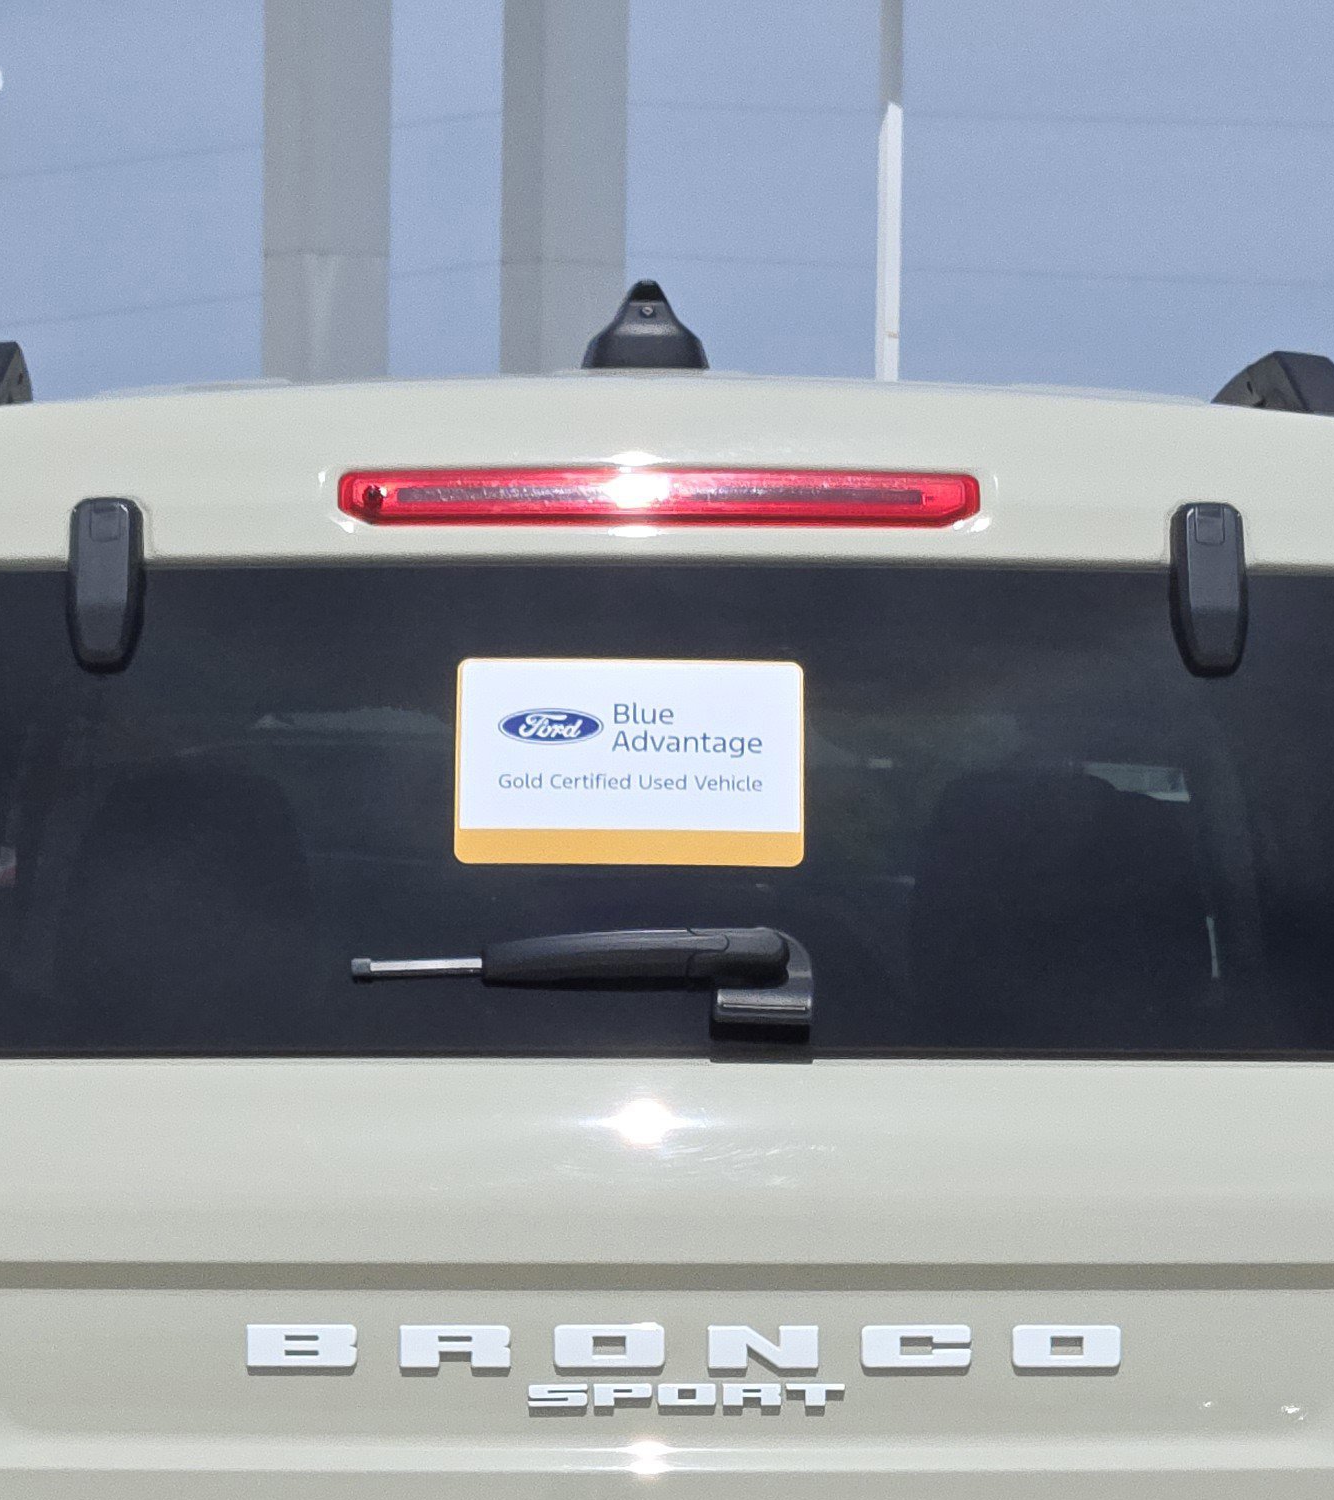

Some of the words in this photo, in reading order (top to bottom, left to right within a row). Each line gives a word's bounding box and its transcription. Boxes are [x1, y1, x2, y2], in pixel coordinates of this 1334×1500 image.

[517, 712, 584, 738] Ford
[612, 701, 675, 726] Blue
[611, 729, 764, 758] Advantage
[498, 773, 543, 790] Gold
[549, 773, 632, 791] Certified
[638, 774, 688, 791] Used
[694, 775, 763, 793] Vehicle
[245, 1323, 1123, 1370] BRONCO
[526, 1383, 846, 1415] SPORT
